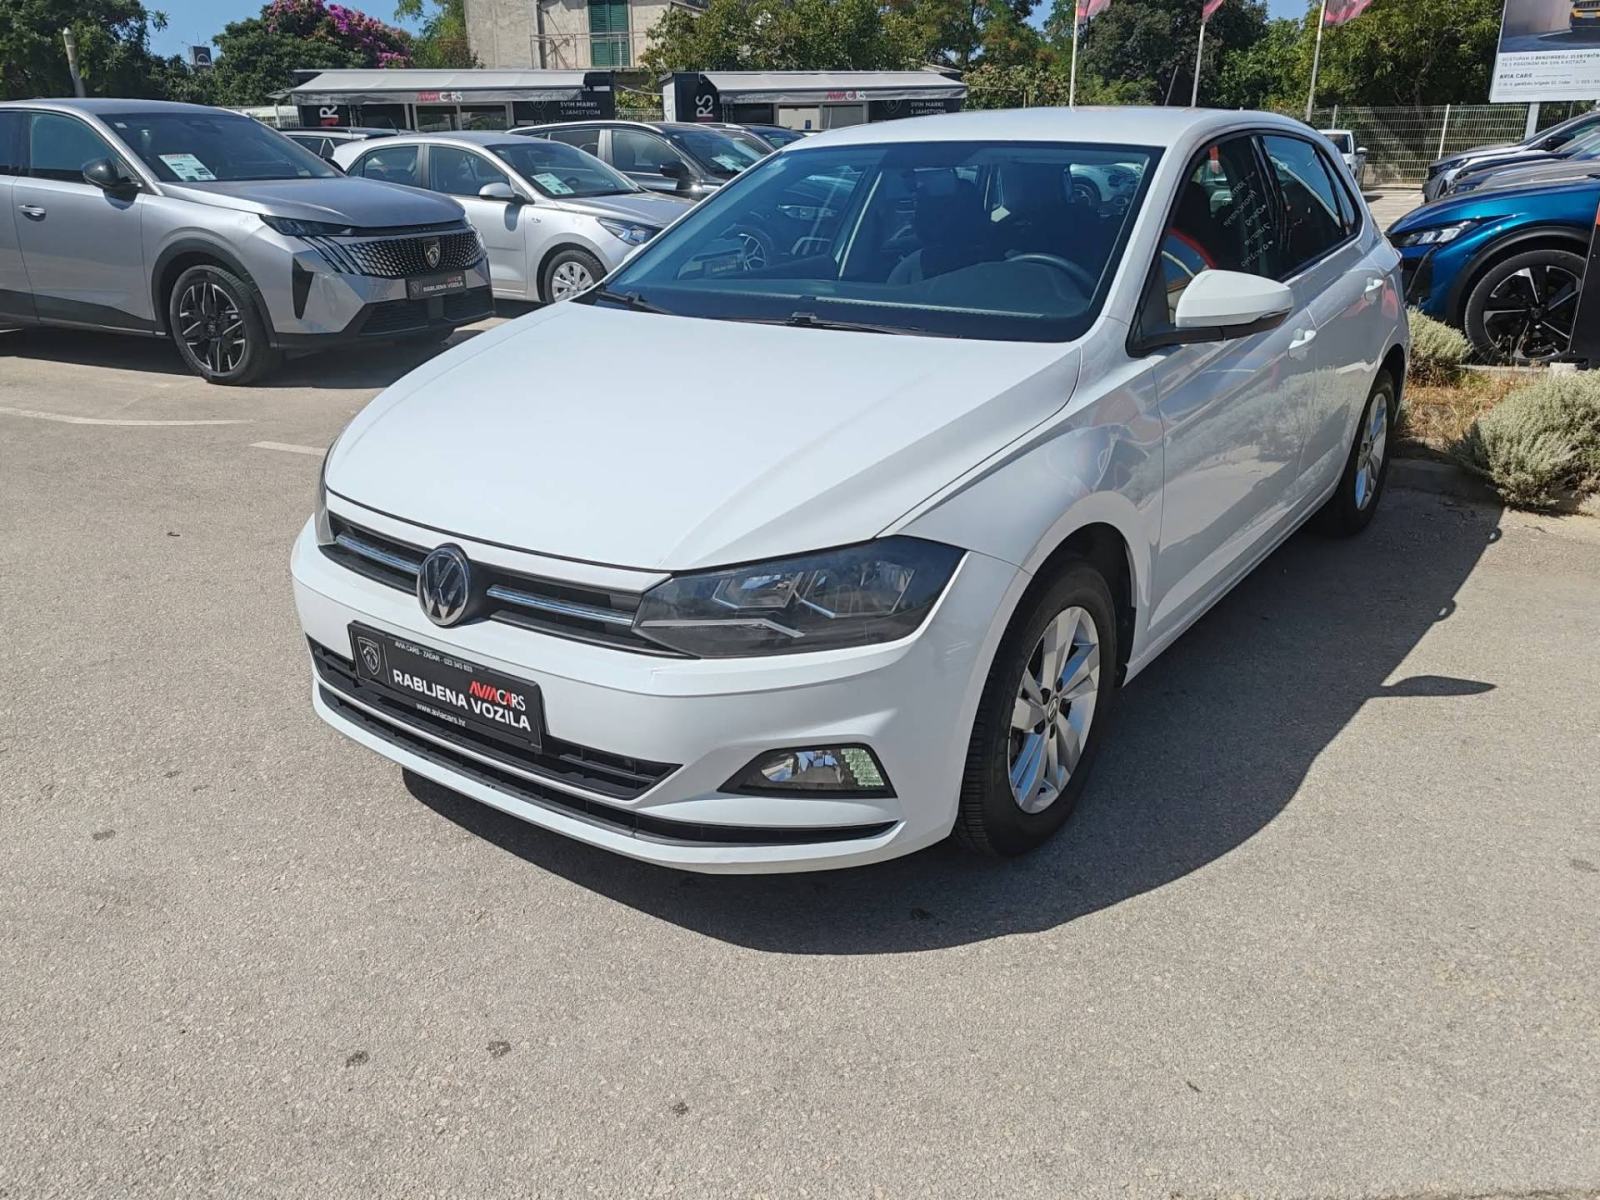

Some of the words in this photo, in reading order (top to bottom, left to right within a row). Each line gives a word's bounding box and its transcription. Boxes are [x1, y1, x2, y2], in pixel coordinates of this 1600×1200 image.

[393, 669, 469, 711] RABLJENA
[470, 698, 532, 732] VOZILA
[469, 680, 526, 712] AVIACARS
